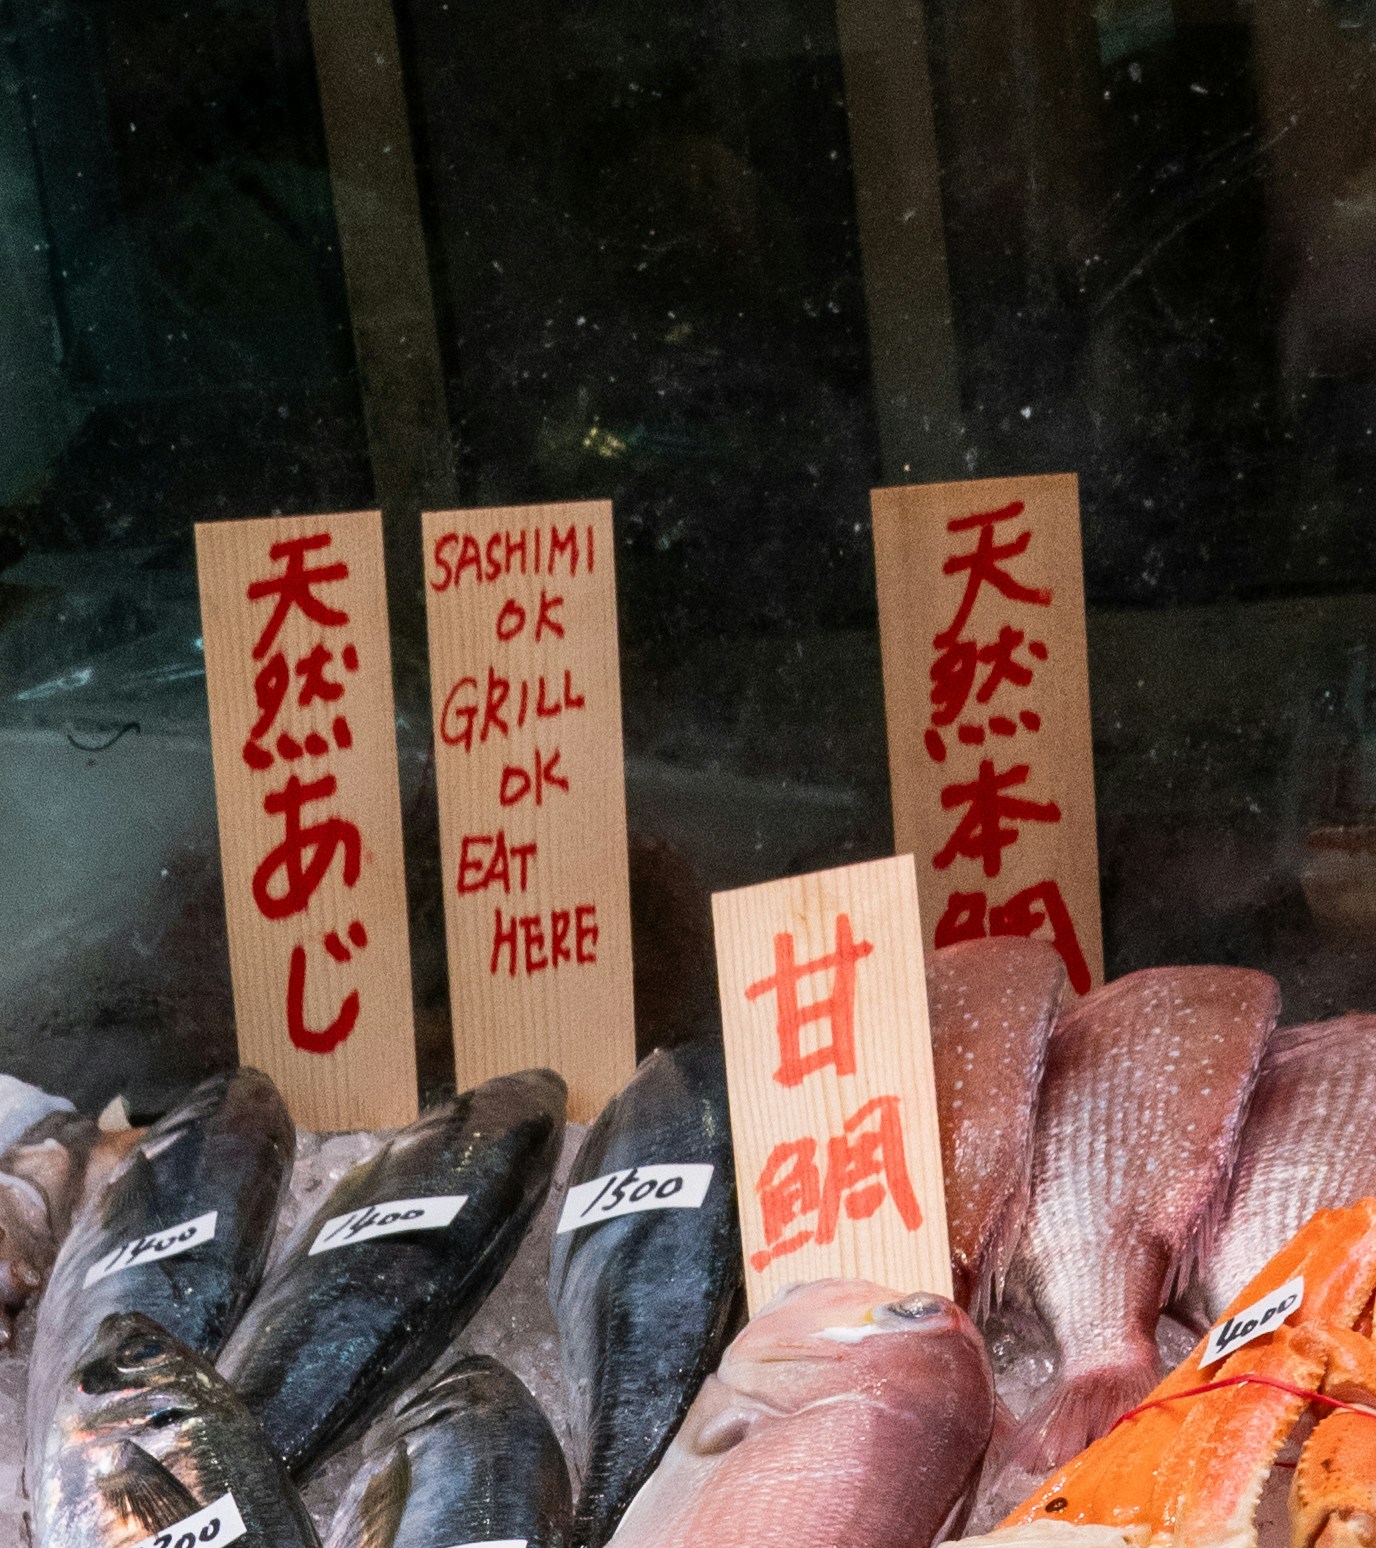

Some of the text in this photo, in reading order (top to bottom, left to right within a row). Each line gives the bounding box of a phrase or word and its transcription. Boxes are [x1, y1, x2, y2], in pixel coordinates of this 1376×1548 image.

[432, 527, 593, 592] SASHIMI
[496, 593, 564, 641] OK
[441, 669, 584, 751] GRILL
[243, 533, 367, 1053] 天然あじ
[500, 752, 568, 806] OK
[457, 831, 536, 895] EAT
[491, 905, 598, 975] HERE
[744, 913, 924, 1273] 甘鯛
[324, 1205, 425, 1242] 1400
[579, 1169, 685, 1215] 1500
[105, 1223, 198, 1263] 1400
[1214, 1292, 1299, 1355] 4000
